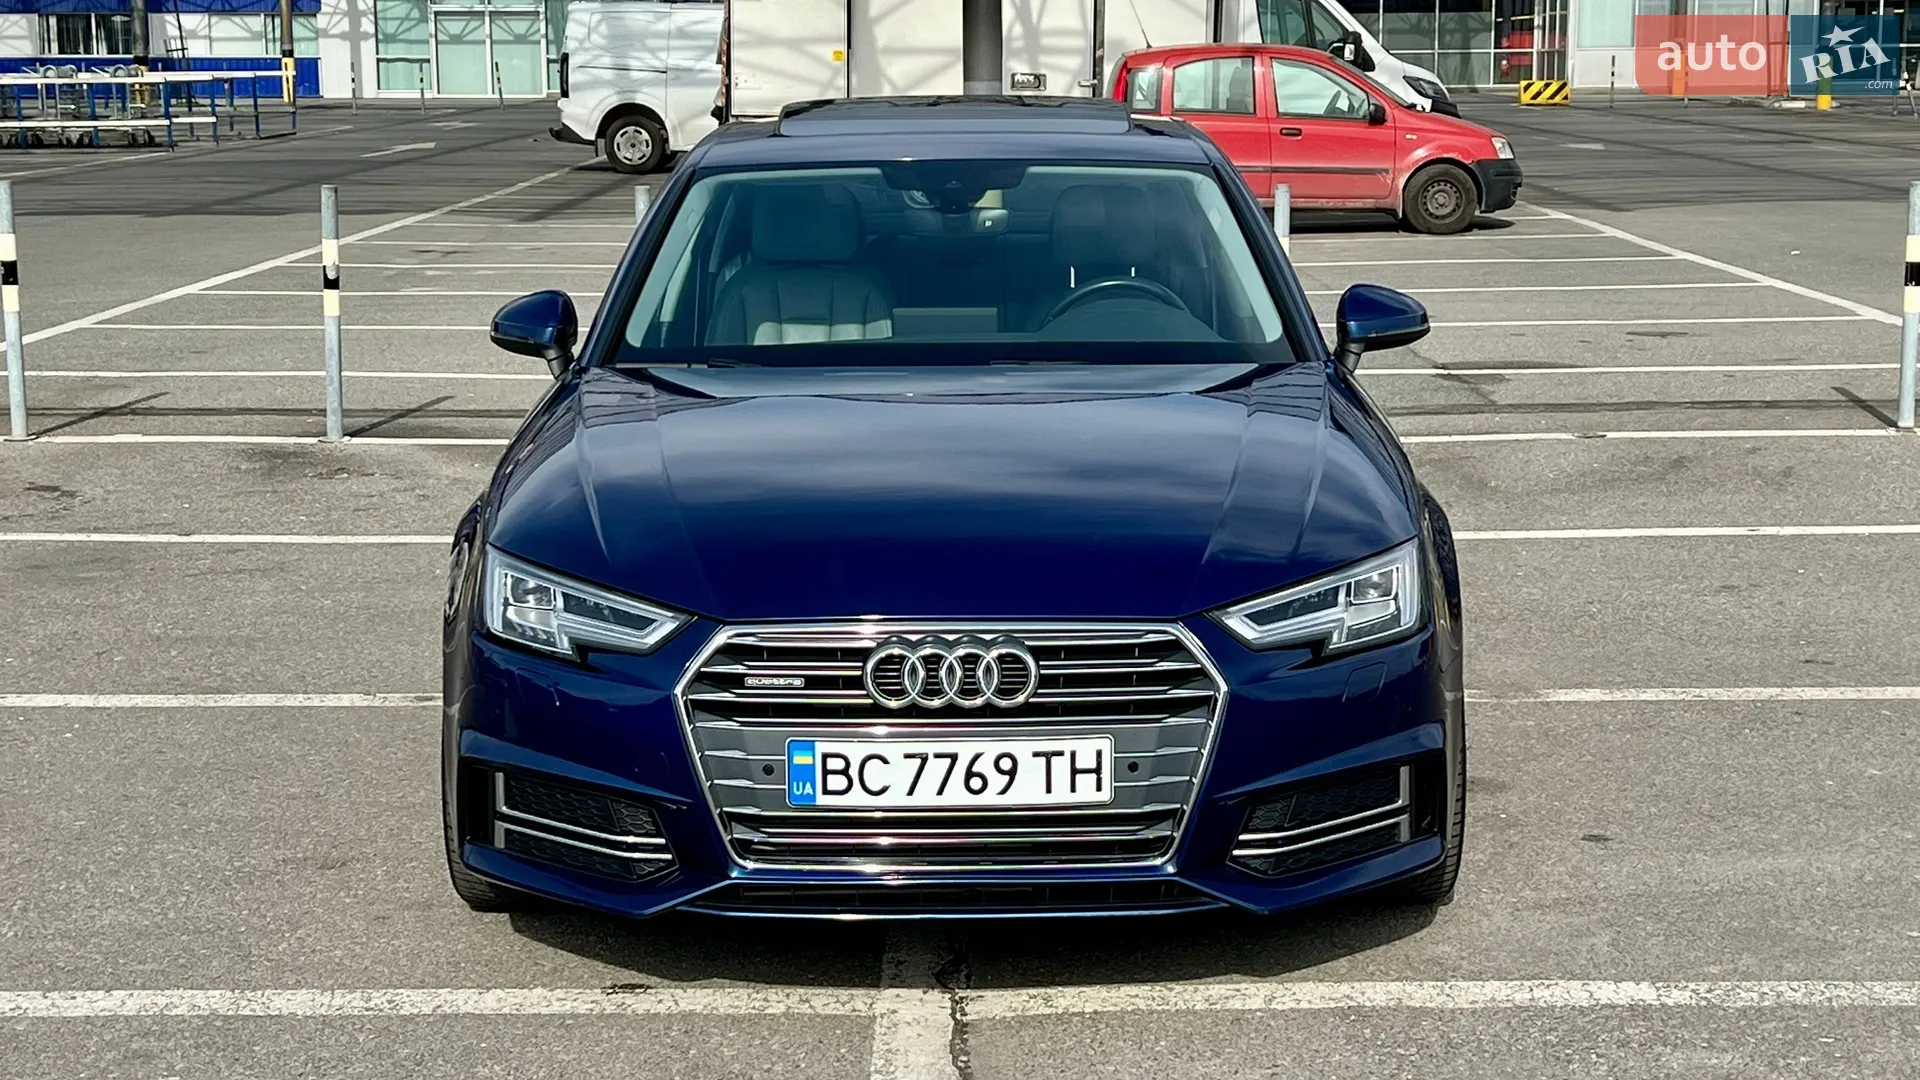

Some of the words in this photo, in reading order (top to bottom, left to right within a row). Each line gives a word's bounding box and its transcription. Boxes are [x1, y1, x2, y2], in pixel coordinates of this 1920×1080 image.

[793, 781, 814, 795] UA
[821, 751, 891, 797] BC
[903, 751, 1019, 797] 7769
[1032, 749, 1103, 795] TH
